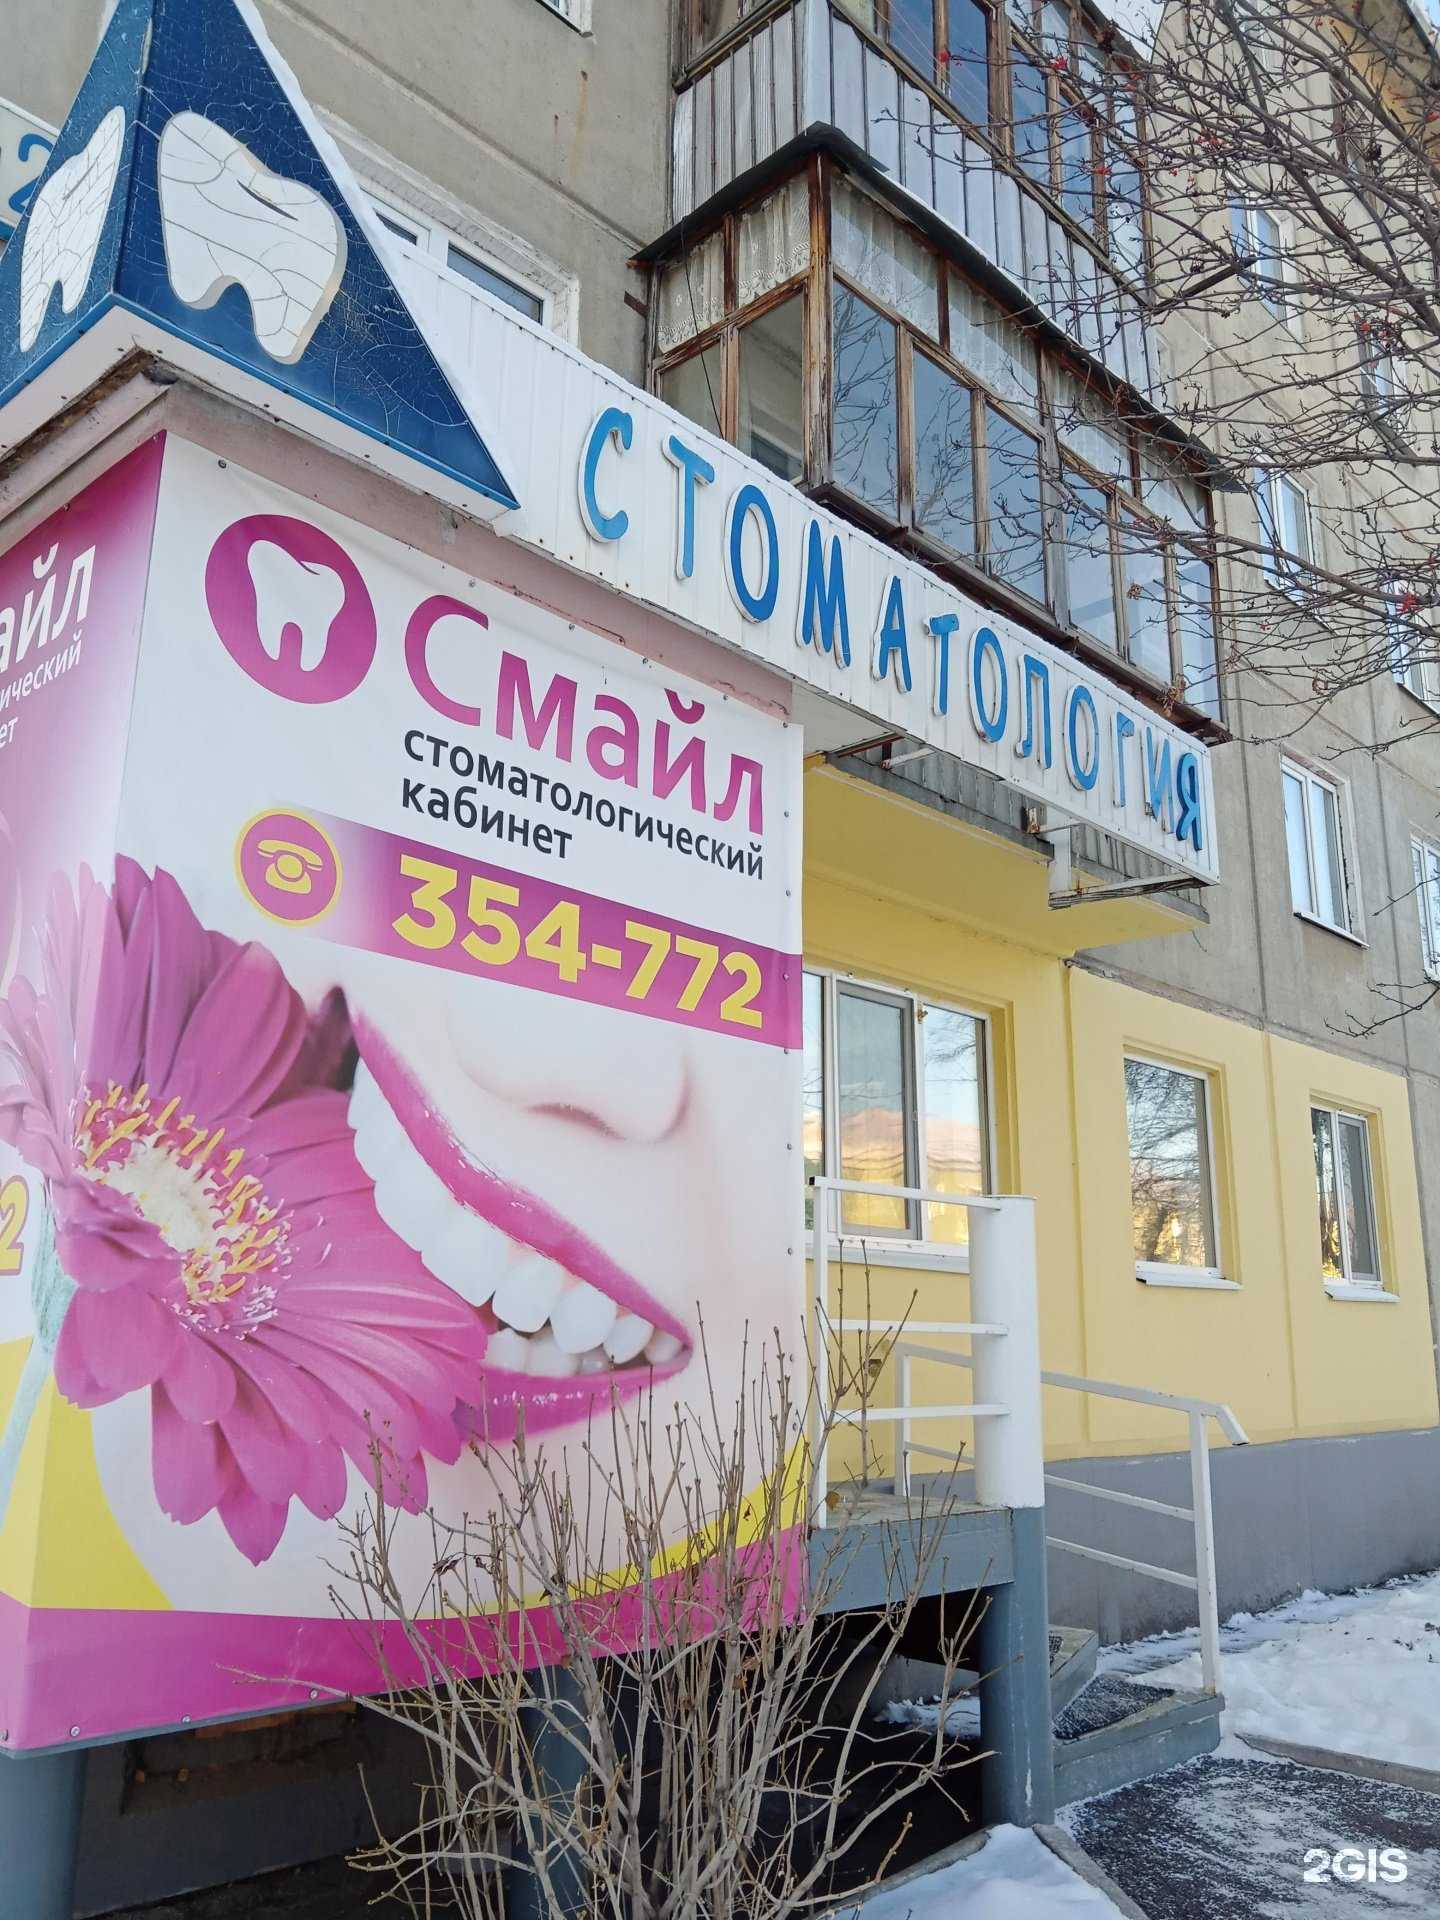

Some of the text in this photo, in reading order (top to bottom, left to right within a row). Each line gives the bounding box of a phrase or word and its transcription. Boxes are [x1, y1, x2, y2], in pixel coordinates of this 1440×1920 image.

[404, 594, 764, 836] Смайл
[579, 407, 1203, 851] СТОМАТОЛОГИЯ
[401, 777, 573, 859] кабинет
[404, 729, 763, 881] стоматологический
[392, 853, 764, 1029] 354-772
